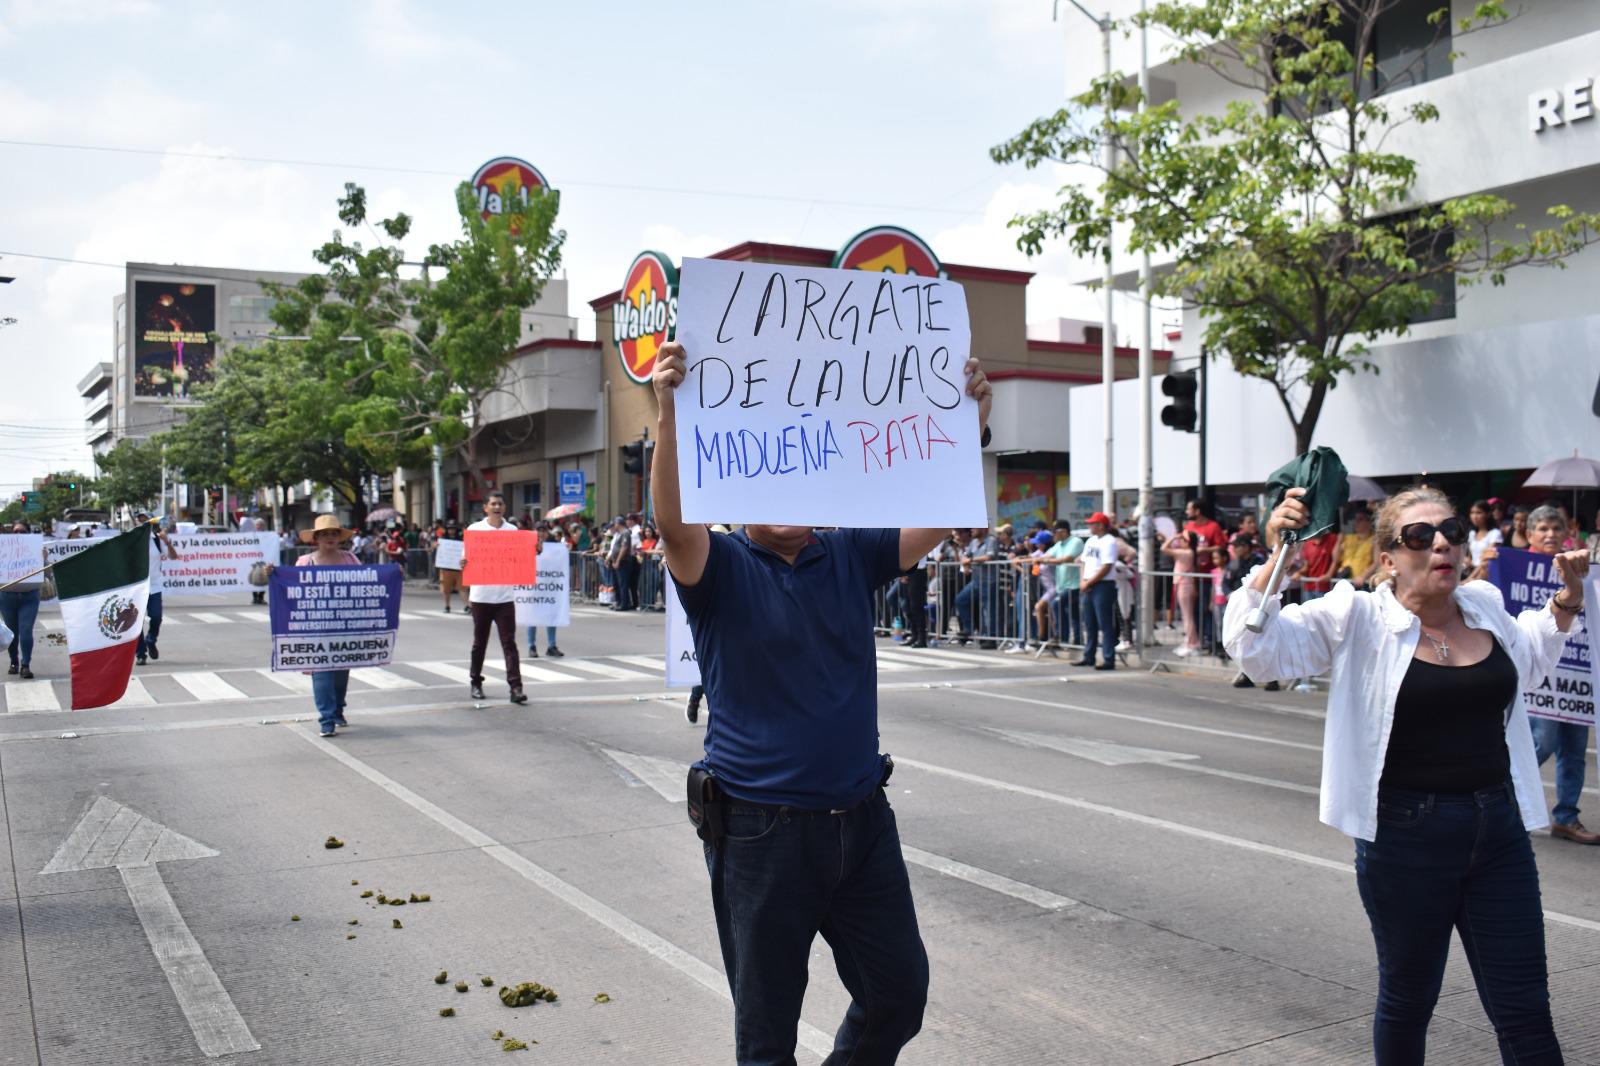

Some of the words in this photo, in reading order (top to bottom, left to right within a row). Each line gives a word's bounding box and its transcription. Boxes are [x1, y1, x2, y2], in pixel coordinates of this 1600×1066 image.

[1528, 76, 1600, 134] RE
[613, 285, 678, 341] Waldo's
[716, 271, 950, 345] LARGATE
[690, 357, 767, 408] DE
[787, 358, 843, 408] LA
[863, 345, 960, 410] UAS
[847, 414, 957, 473] RATA
[48, 543, 88, 556] xigimo
[181, 539, 188, 549] y
[190, 538, 200, 547] la
[202, 537, 260, 547] devolucion
[176, 552, 234, 562] egalmente
[235, 551, 264, 559] como
[168, 566, 237, 577] trabajadores
[300, 571, 313, 583] LA
[316, 568, 378, 583] AUTONOMÍA
[1526, 561, 1545, 582] LA
[163, 579, 185, 588] ción
[188, 579, 201, 587] de
[203, 578, 217, 586] las
[513, 582, 564, 592] ENDICIÓN
[287, 587, 302, 599] NO
[305, 584, 330, 599] ESTÁ
[334, 586, 347, 598] EN
[1511, 582, 1529, 602] NO
[1532, 585, 1555, 605] EST
[355, 600, 364, 608] LA
[290, 611, 305, 620] POR
[308, 610, 334, 619] TANTOS
[280, 643, 324, 654] FUERA
[329, 638, 389, 651] MADUEÑA
[281, 654, 329, 665] RECTOR
[332, 651, 388, 663] CORRUPTO
[1556, 677, 1593, 697] MAD
[1524, 691, 1555, 708] TOR
[1558, 697, 1595, 715] CORR
